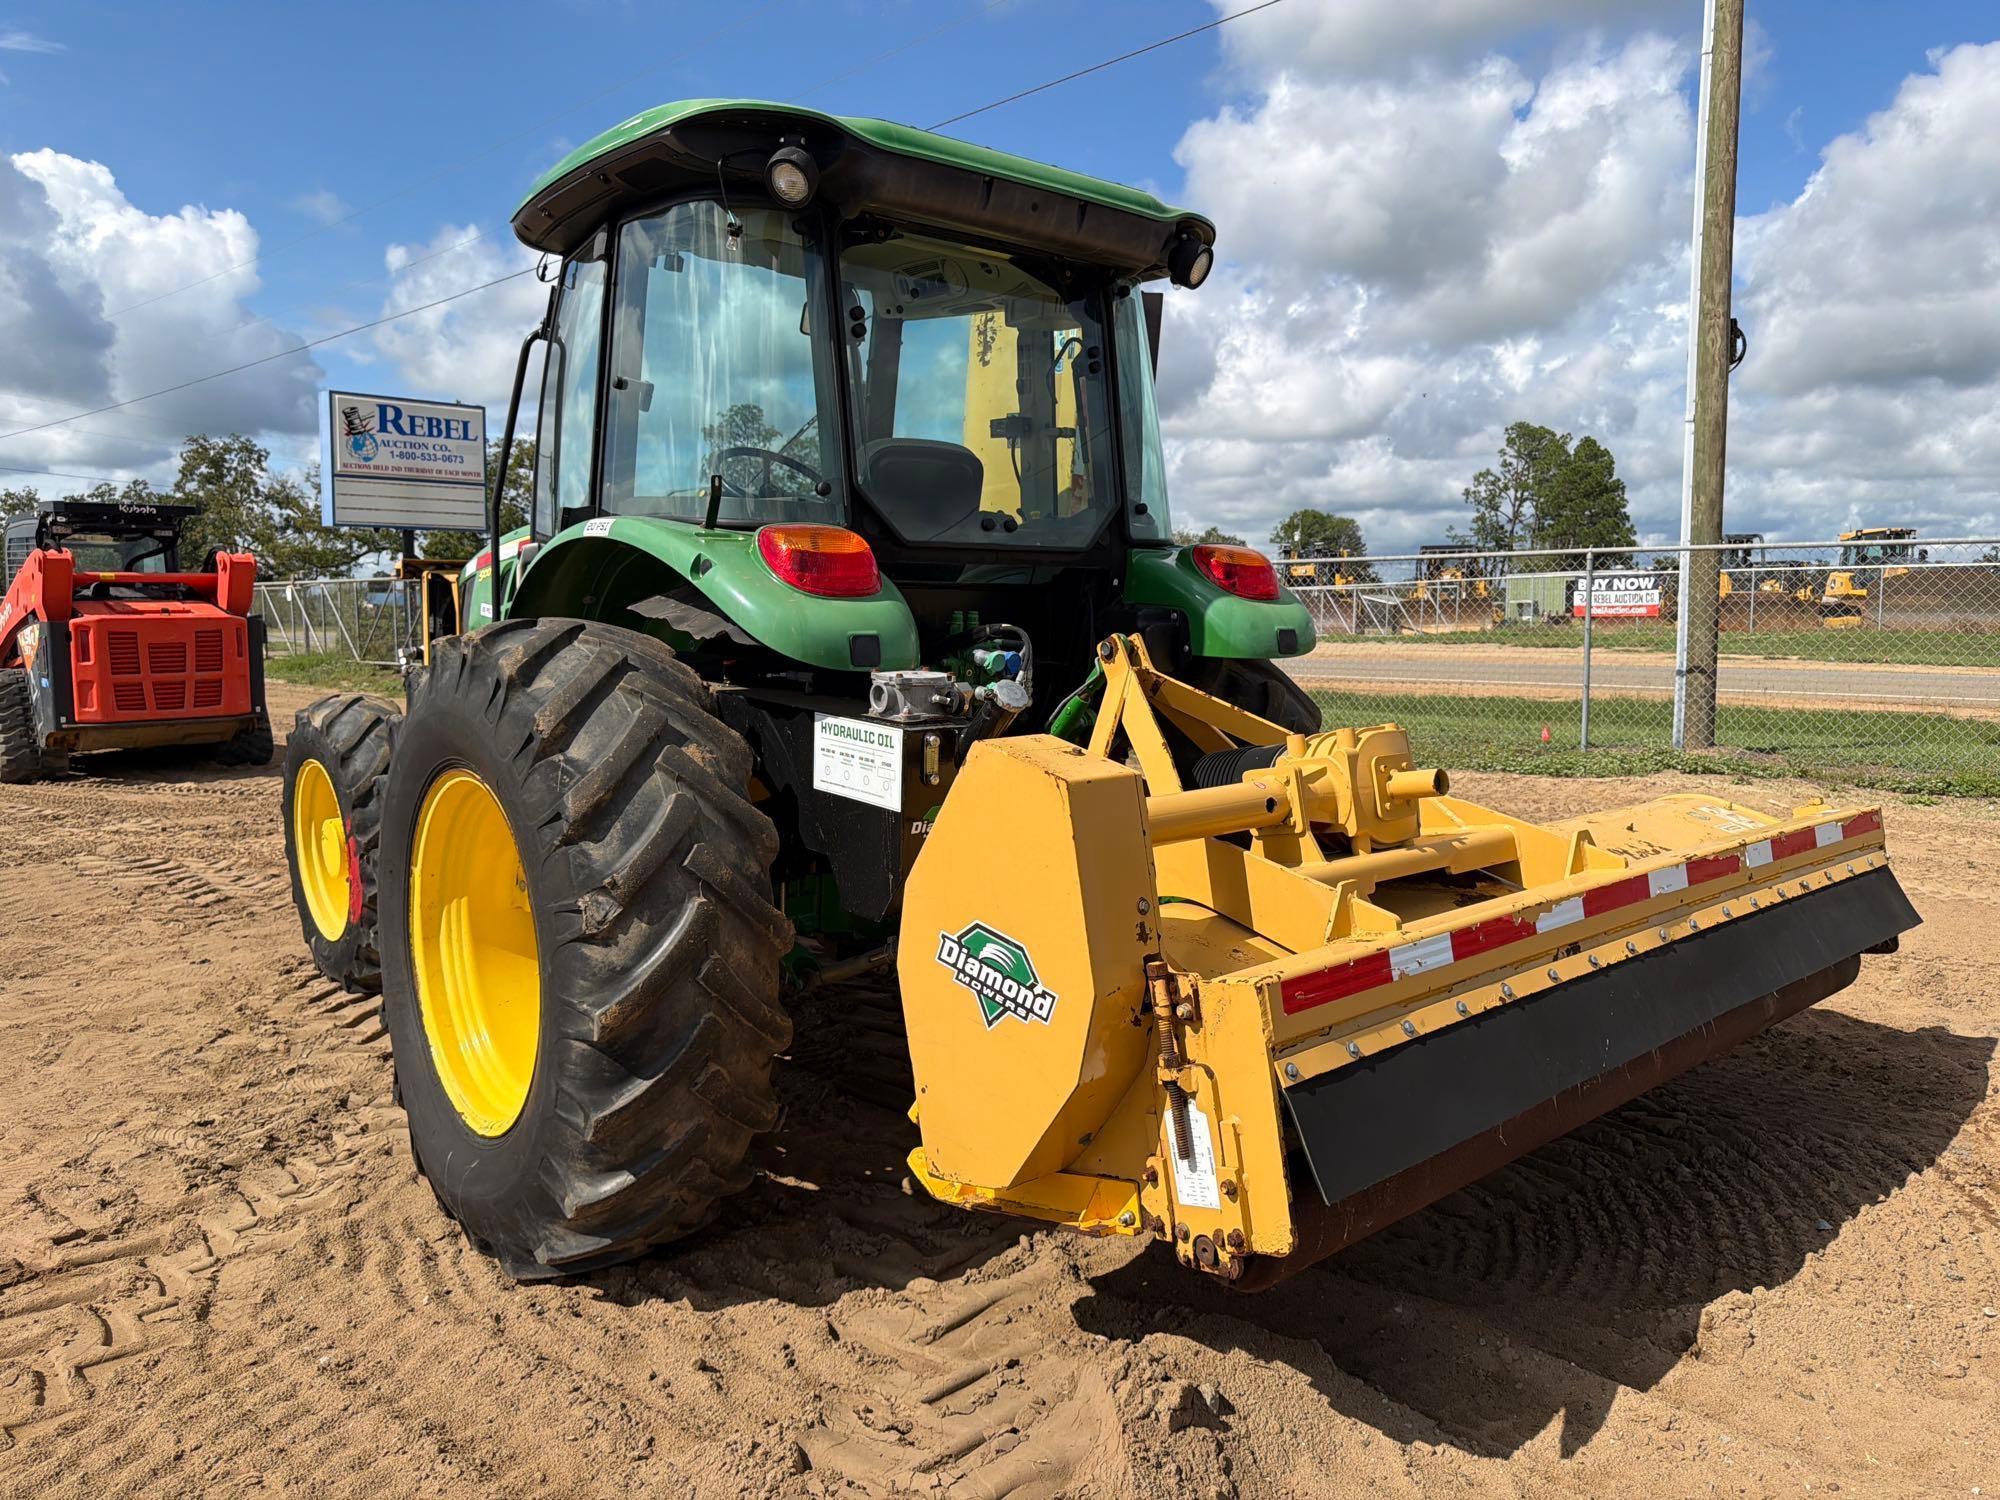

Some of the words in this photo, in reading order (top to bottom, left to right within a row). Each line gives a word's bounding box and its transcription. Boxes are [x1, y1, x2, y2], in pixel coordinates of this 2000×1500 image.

[376, 404, 479, 442] REBEL
[380, 439, 429, 450] AUCTION
[432, 443, 451, 453] CO.
[390, 450, 464, 464] 1-800-533-0673
[342, 462, 371, 471] AUCTIONS
[391, 465, 403, 473] 2ND
[404, 466, 434, 475] THURSDAY
[461, 470, 482, 478] MONTH
[119, 504, 157, 514] Kubota
[1577, 578, 1610, 591] BUY
[1613, 577, 1655, 591] NOW
[1593, 593, 1612, 604] REBEL
[1614, 593, 1644, 604] AUCTION
[1645, 592, 1657, 603] CO.
[820, 721, 875, 744] HYDRAULIC
[877, 733, 895, 749] OIL
[940, 938, 1053, 1019] Diamond
[957, 972, 1028, 1017] MOWERS
